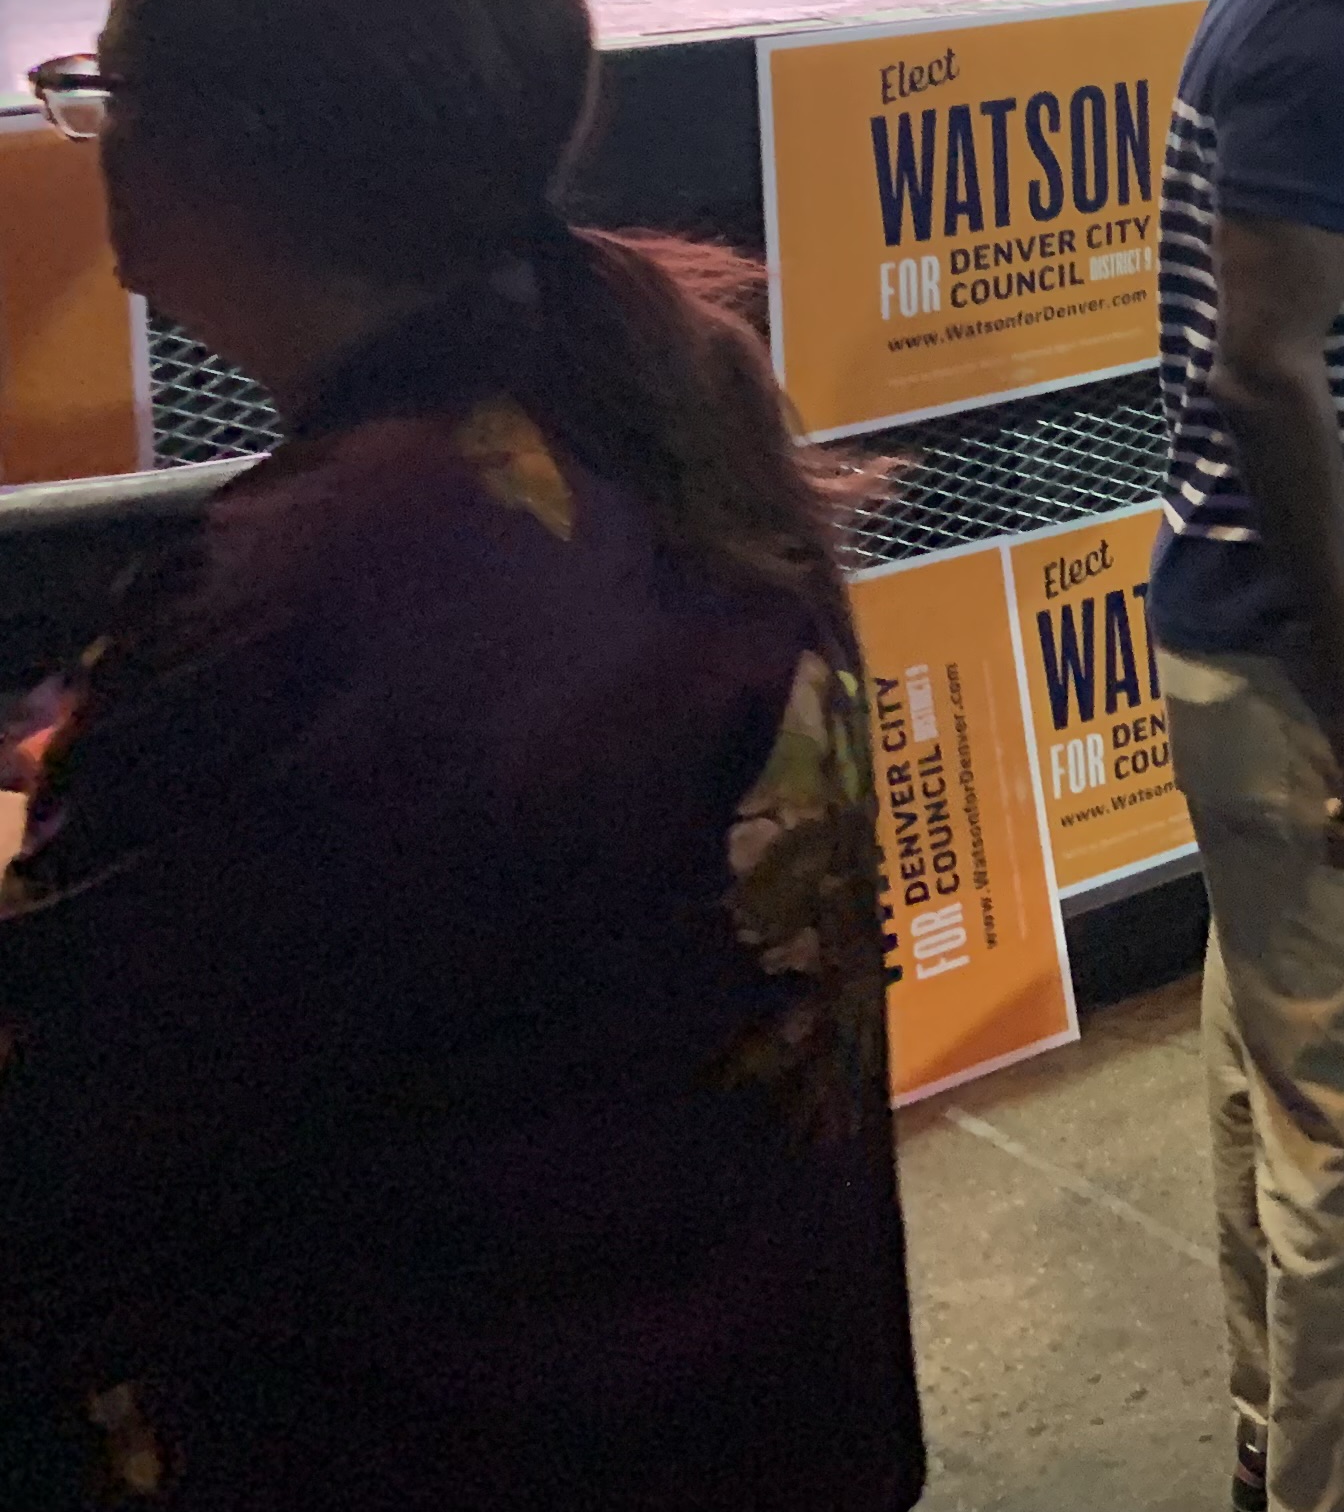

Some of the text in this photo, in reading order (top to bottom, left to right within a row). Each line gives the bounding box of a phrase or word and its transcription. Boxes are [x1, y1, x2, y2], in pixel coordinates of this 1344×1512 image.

[880, 47, 959, 105] Elect
[870, 79, 1152, 246] WATSON
[880, 215, 1152, 321] FOR DENVER CITY
[950, 261, 1085, 309] COUNCIL
[1090, 248, 1141, 281] DISTRICT
[888, 289, 1148, 352] www.WatsonforDenver.com
[1043, 538, 1114, 600] Elect
[1036, 582, 1161, 731] WAT
[875, 676, 908, 753] CITY
[1050, 710, 1166, 801] FOR DEN
[886, 759, 931, 906] DENVER
[918, 742, 960, 896] COUNCIL
[1060, 780, 1176, 828] www.Watson
[911, 901, 970, 980] FOR
